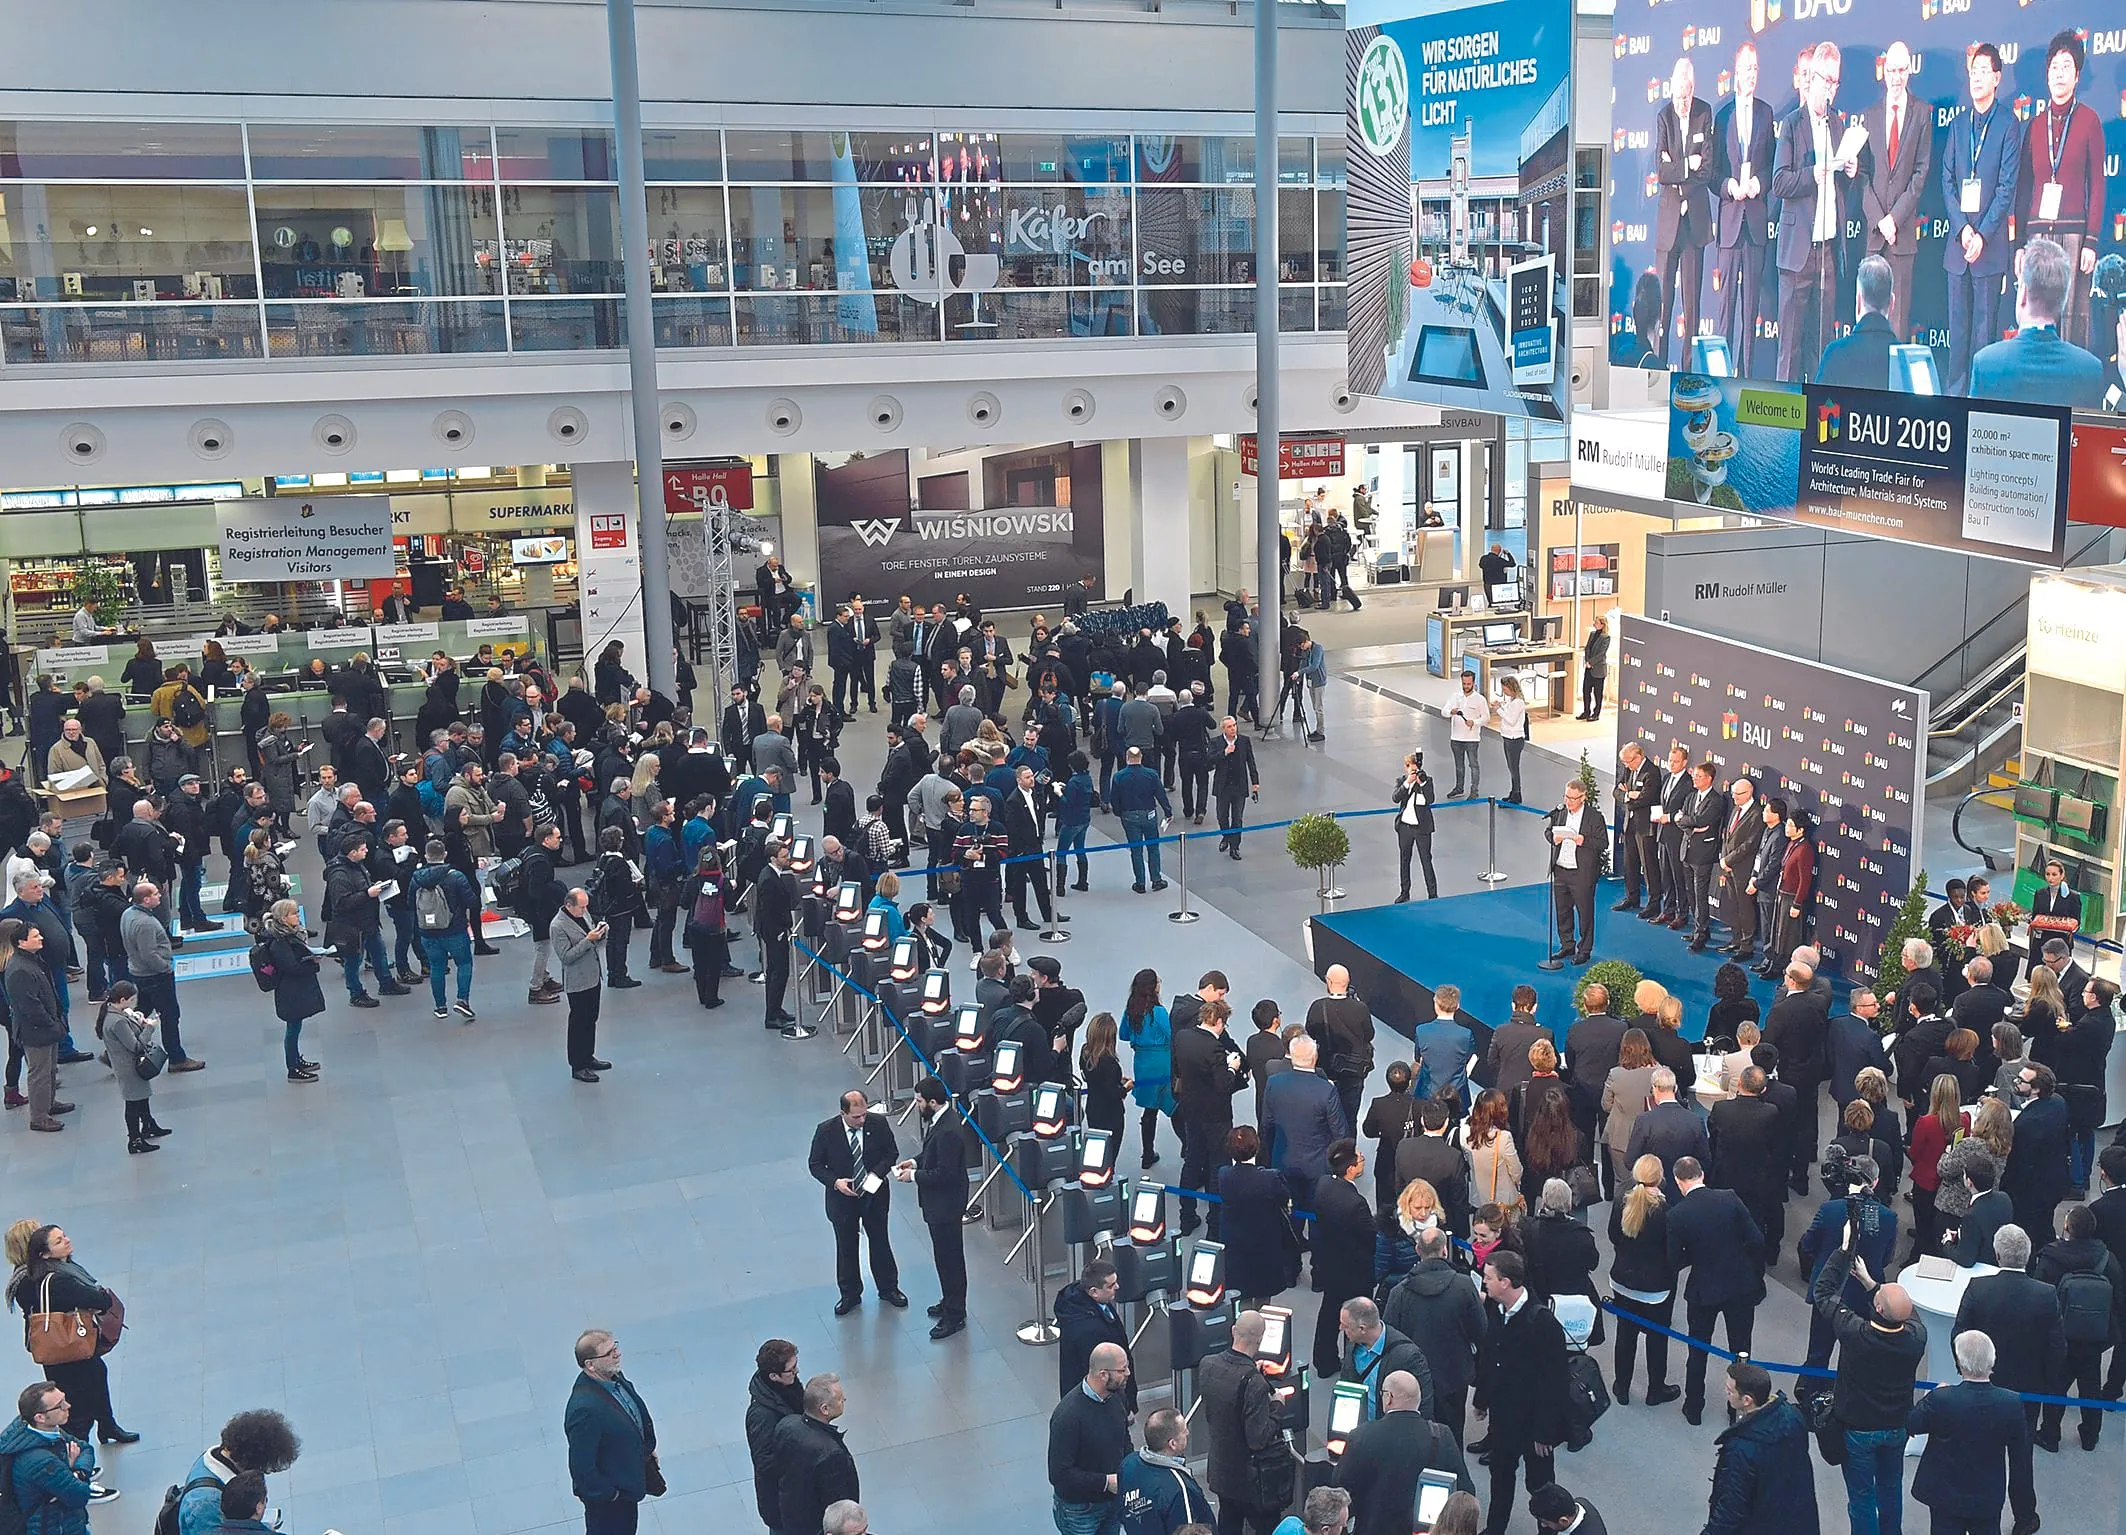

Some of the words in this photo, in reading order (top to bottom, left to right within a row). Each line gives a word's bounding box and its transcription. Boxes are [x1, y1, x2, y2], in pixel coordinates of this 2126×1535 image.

[1698, 26, 1721, 47] BAU
[1422, 40, 1447, 65] WIR
[1447, 31, 1499, 62] SORGEN
[1629, 35, 1650, 54] BAU
[1422, 65, 1447, 96] FÜR
[1448, 58, 1538, 93] NATÜRLICHES
[1422, 100, 1457, 126] LICHT
[1628, 131, 1649, 149] BAU
[1009, 204, 1107, 253] Käfer
[1626, 224, 1647, 242] BAU
[1087, 258, 1128, 275] am
[1143, 250, 1186, 275] See
[1746, 399, 1787, 418] Welcome
[1791, 404, 1801, 419] to
[1848, 412, 1890, 446] BAU
[1896, 417, 1951, 453] 2019
[1972, 428, 1998, 441] 20,000
[1578, 439, 1600, 464] RM
[1602, 449, 1633, 467] Rudolf
[1634, 453, 1666, 473] Müller
[1971, 445, 2007, 457] exhibition
[2009, 449, 2030, 460] space
[2031, 453, 2054, 463] more:
[1811, 461, 1839, 476] World's
[1841, 465, 1870, 483] Leading
[1872, 469, 1893, 484] Trade
[1895, 473, 1910, 487] Fair
[1912, 475, 1925, 489] for
[1970, 468, 1999, 484] Lighting
[2000, 475, 2038, 488] concepts/
[1809, 479, 1857, 498] Architecture,
[1859, 486, 1895, 502] Materials
[1897, 494, 1912, 505] and
[1914, 494, 1947, 511] Systems
[1969, 483, 1998, 498] Building
[2000, 490, 2048, 505] automation/
[1808, 504, 1903, 528] www.bau-muenchen.com
[1968, 499, 2014, 515] Construction
[2016, 505, 2039, 520] tools/
[917, 512, 1075, 541] WIŚNIOWSKI
[1967, 515, 1981, 526] Bau
[1983, 516, 1990, 526] IT
[226, 525, 326, 542] Registrierleitung
[329, 523, 385, 537] Besucher
[228, 546, 301, 561] Registration
[305, 545, 387, 559] Management
[287, 561, 332, 574] Visitors
[881, 560, 907, 571] TORE,
[909, 558, 951, 569] FENSTER,
[952, 555, 984, 566] TÜREN,
[985, 551, 1048, 564] ZAUNSYSTEME
[934, 571, 944, 579] IN
[945, 569, 968, 579] EINEM
[969, 568, 997, 577] DESIGN
[1026, 585, 1048, 593] STAND
[1048, 584, 1060, 592] 220
[1695, 583, 1719, 600] RM
[1722, 585, 1754, 598] Rudolf
[1756, 581, 1788, 595] Müller
[2055, 624, 2099, 643] Heinze
[1630, 657, 1642, 667] BAU
[1664, 666, 1675, 678] BAU
[1698, 677, 1711, 688] BAU
[1646, 684, 1658, 696] BAU
[1735, 688, 1747, 699] BAU
[1680, 695, 1692, 706] BAU
[1772, 699, 1786, 711] BAU
[1629, 702, 1640, 713] BAU
[1662, 713, 1674, 724] BAU
[1812, 711, 1826, 723] BAU
[1644, 730, 1656, 742] BAU
[1696, 724, 1708, 736] BAU
[1742, 721, 1771, 750] BAU
[1853, 723, 1868, 736] BAU
[1790, 730, 1804, 743] BAU
[1831, 743, 1845, 756] BAU
[1897, 737, 1912, 750] BAU
[1713, 754, 1726, 766] BAU
[1874, 756, 1889, 769] BAU
[1750, 767, 1763, 779] BAU
[1809, 762, 1823, 775] BAU
[1788, 780, 1802, 793] BAU
[1851, 776, 1865, 789] BAU
[1828, 794, 1842, 808] BAU
[1894, 790, 1909, 804] BAU
[1871, 809, 1886, 823] BAU
[1848, 828, 1863, 841] BAU
[1826, 846, 1840, 859] BAU
[1892, 844, 1907, 857] BAU
[1869, 862, 1883, 875] BAU
[1846, 879, 1860, 892] BAU
[1708, 896, 1720, 909] BAU
[1824, 896, 1838, 909] BAU
[1867, 914, 1881, 927] BAU
[1844, 930, 1858, 944] BAU
[1822, 946, 1836, 959] BAU
[1864, 965, 1880, 979] BAU
